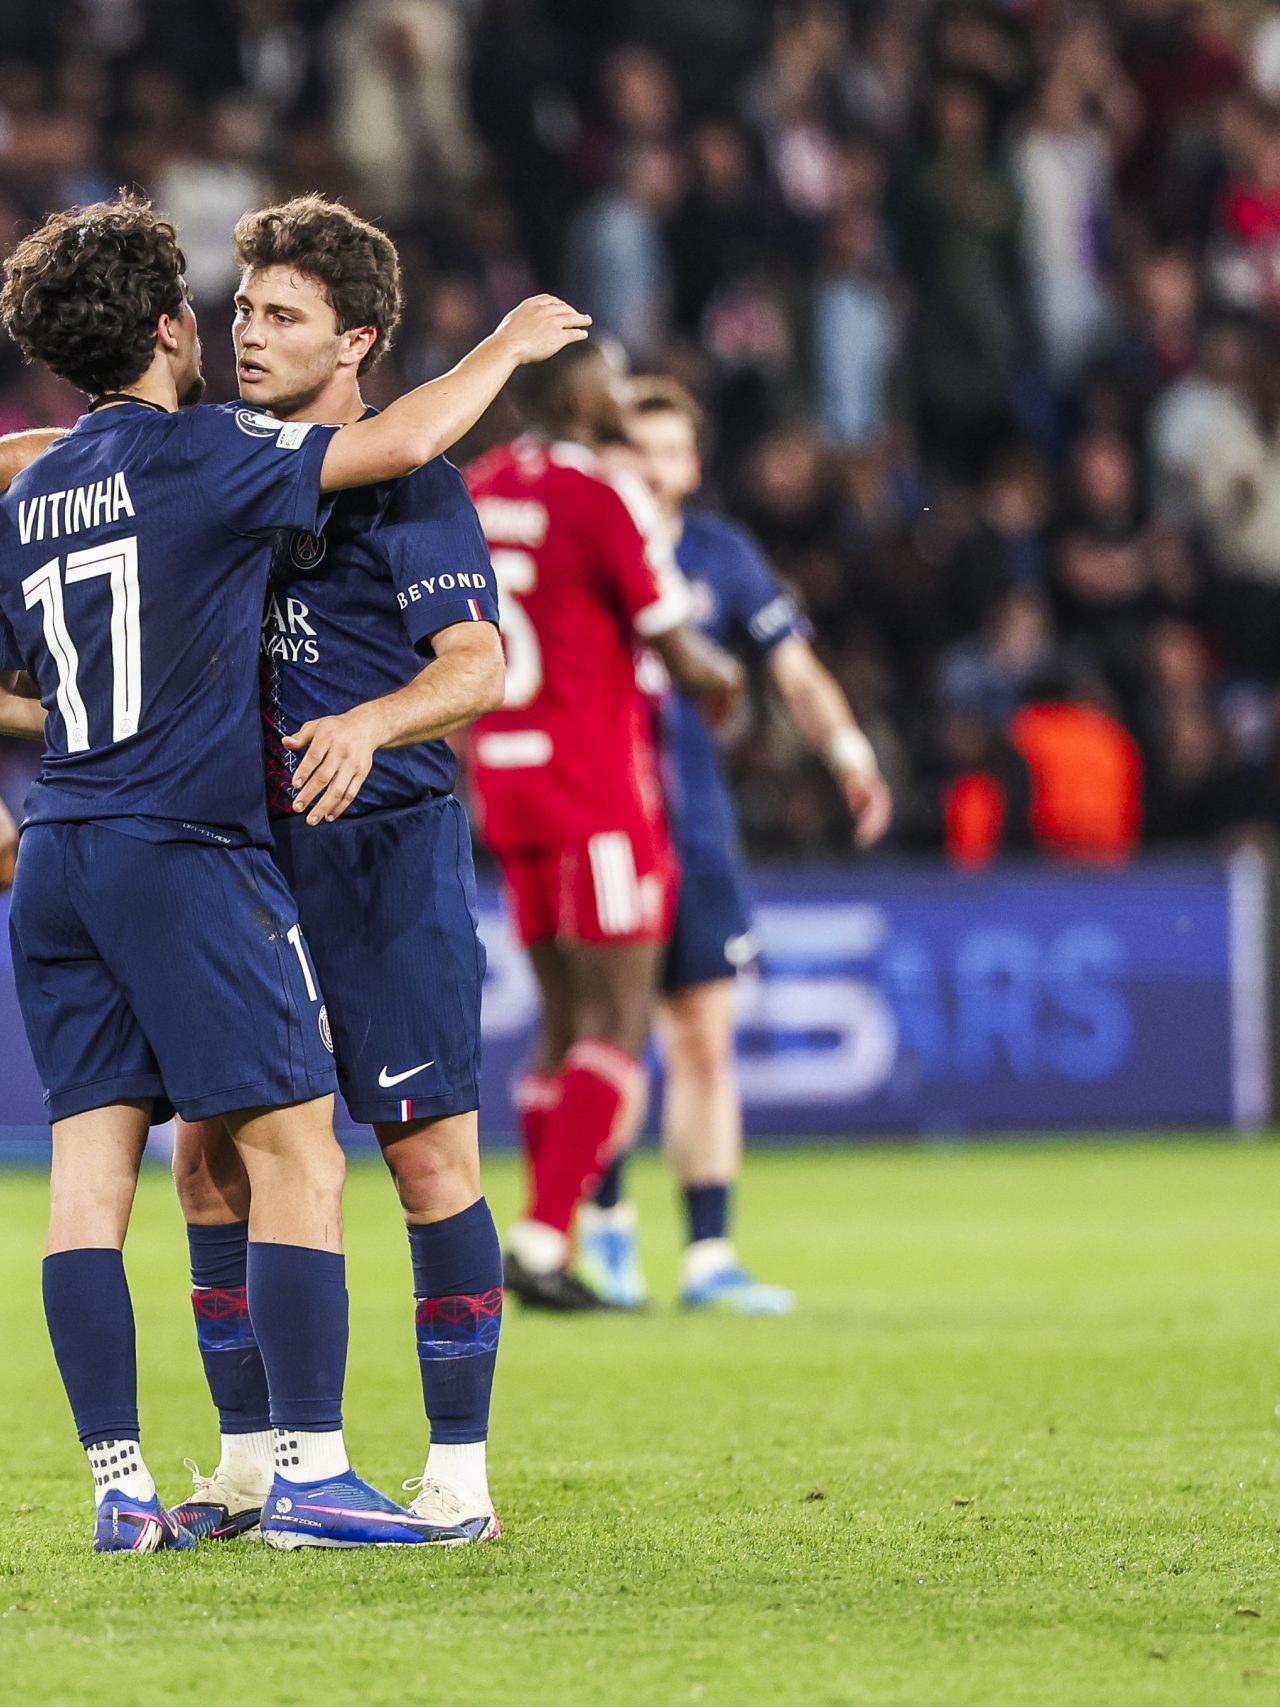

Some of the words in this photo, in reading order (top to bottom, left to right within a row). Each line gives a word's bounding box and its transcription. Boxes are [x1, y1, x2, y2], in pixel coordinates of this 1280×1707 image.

[18, 471, 136, 545] VITINHA
[262, 591, 317, 636] AR
[396, 572, 487, 610] BEYOND
[21, 536, 142, 753] 17
[260, 633, 320, 664] WAYS
[286, 923, 318, 1001] 1
